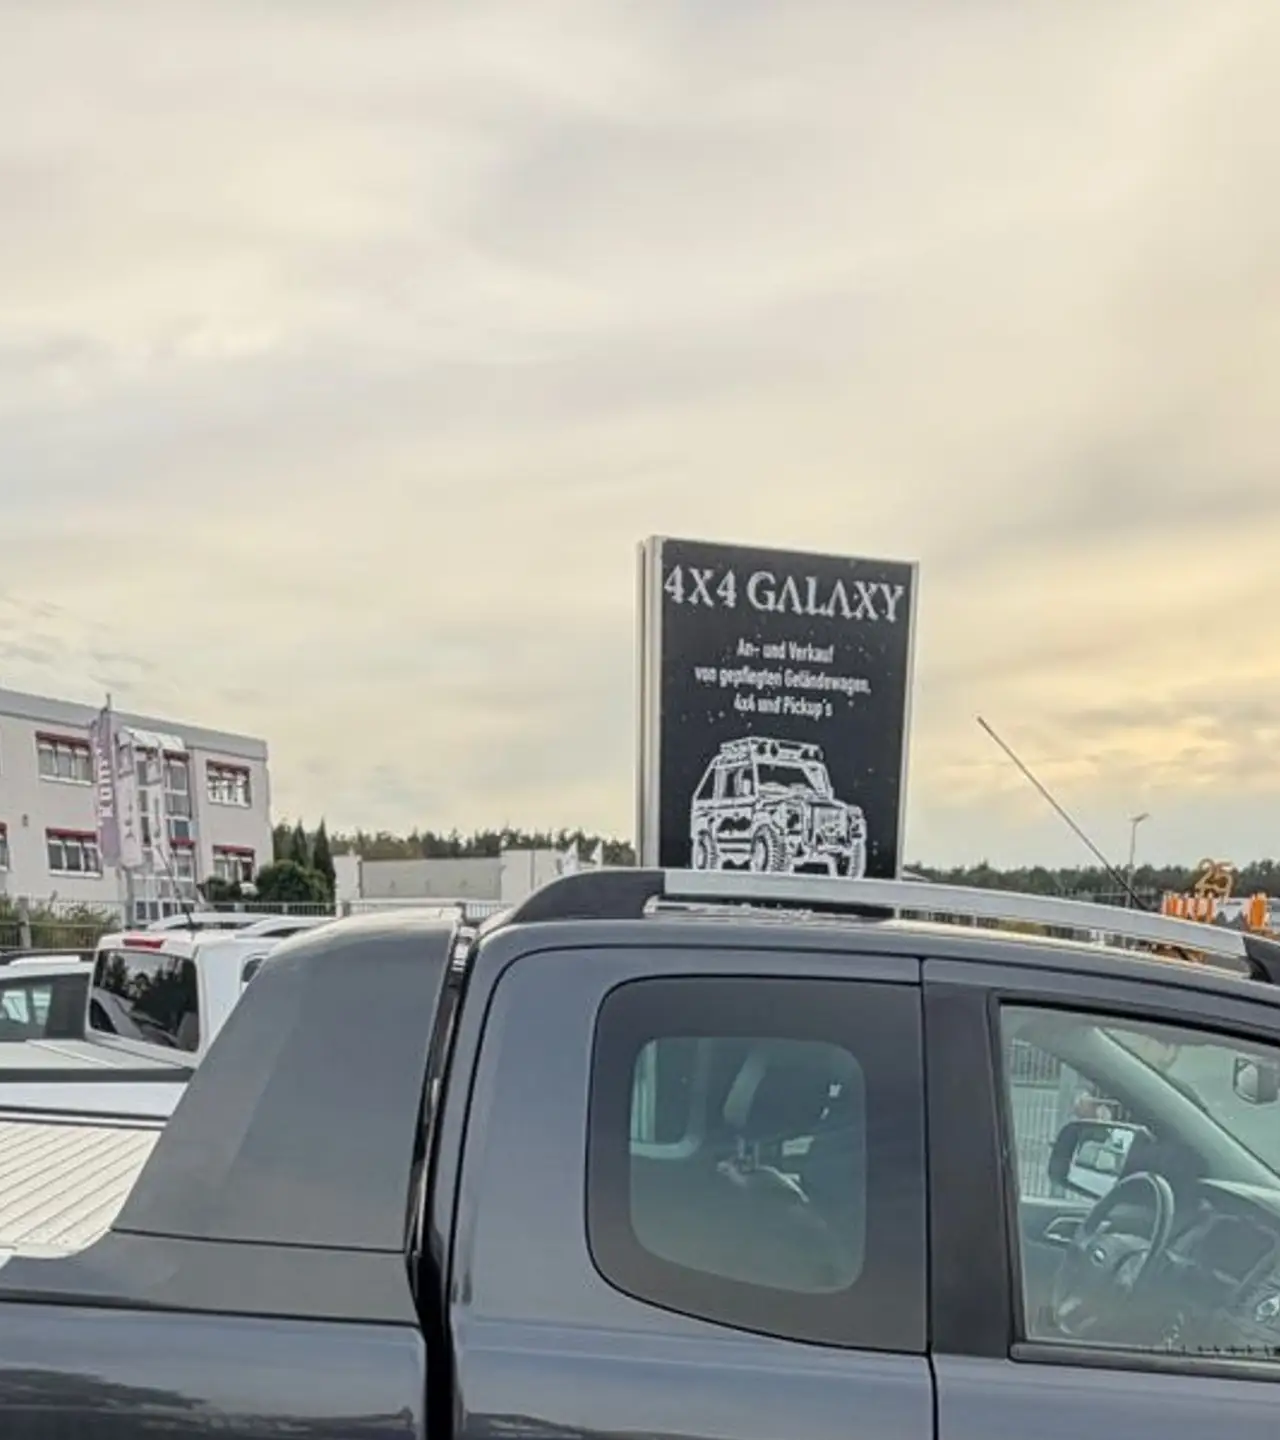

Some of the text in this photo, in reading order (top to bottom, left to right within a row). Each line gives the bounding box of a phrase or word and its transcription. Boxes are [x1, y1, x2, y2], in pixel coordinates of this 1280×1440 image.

[664, 564, 905, 623] 4X4 GALAXY
[762, 640, 786, 660] und
[788, 641, 834, 664] Verkauf
[719, 665, 782, 690] gepflegten
[757, 696, 781, 714] und
